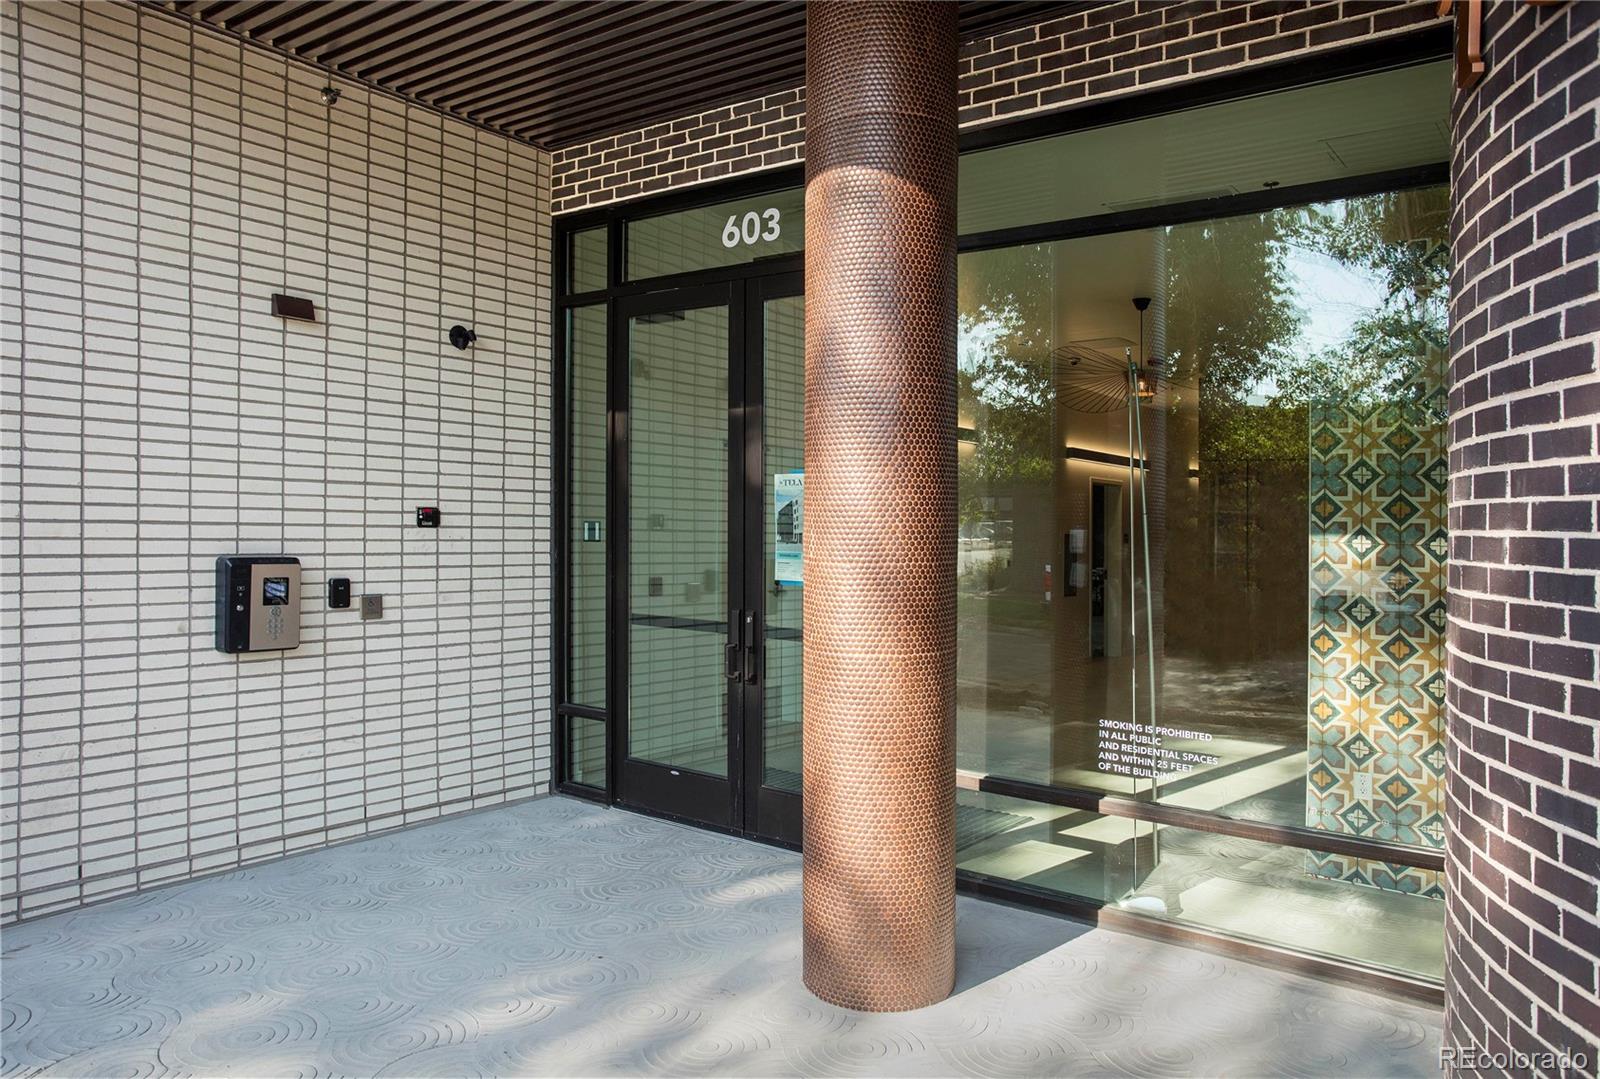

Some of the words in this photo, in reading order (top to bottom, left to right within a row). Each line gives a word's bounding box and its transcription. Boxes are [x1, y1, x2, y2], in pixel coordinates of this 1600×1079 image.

[721, 207, 781, 248] 603
[1098, 719, 1143, 733] SMOKING
[1144, 725, 1154, 733] IS
[1155, 726, 1213, 741] PROHIBITED
[1098, 730, 1109, 738] IN
[1110, 732, 1128, 741] ALL
[1129, 735, 1162, 746] PUBLIC
[1098, 741, 1120, 750] AND
[1121, 744, 1180, 760] RESIDENTIAL
[1182, 753, 1219, 765] SPACES
[1098, 752, 1120, 761] AND
[1120, 754, 1155, 767] WITHIN
[1156, 760, 1168, 769] 25
[1170, 762, 1194, 773] FEET
[1098, 762, 1111, 770] OF
[1112, 764, 1131, 774] THE
